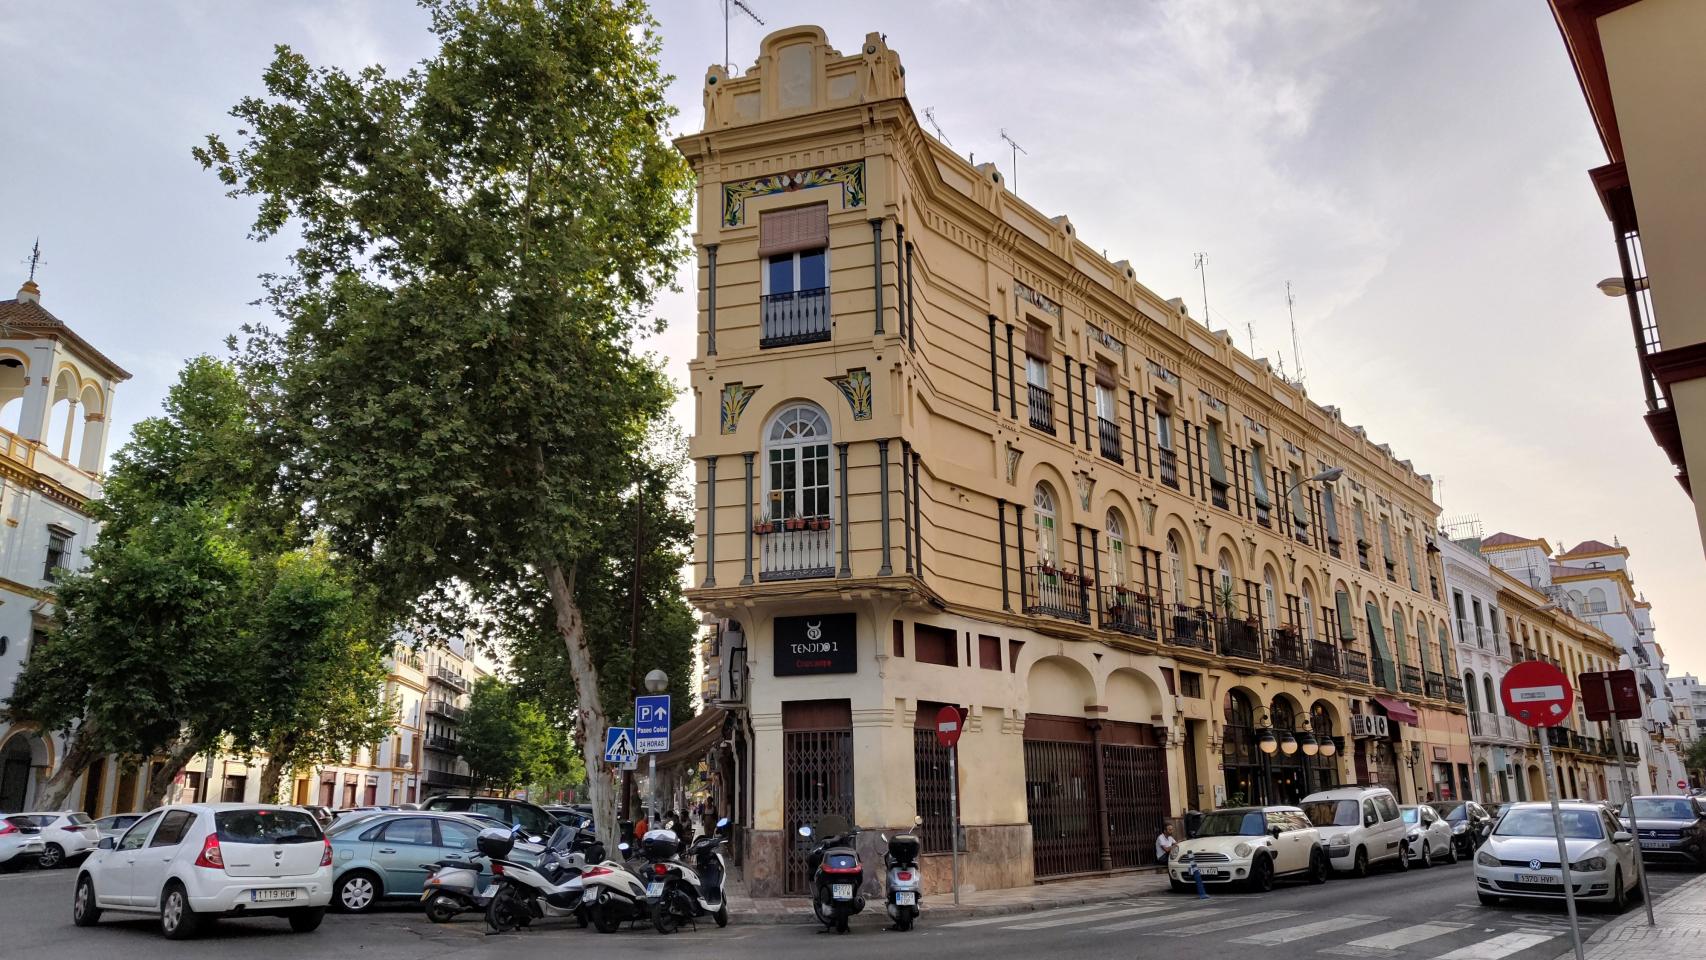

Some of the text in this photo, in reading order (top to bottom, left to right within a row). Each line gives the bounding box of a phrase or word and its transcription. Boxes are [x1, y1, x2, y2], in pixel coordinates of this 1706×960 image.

[832, 641, 839, 652] 1
[641, 707, 650, 720] P
[647, 740, 665, 748] HORAS
[258, 889, 279, 899] 1119
